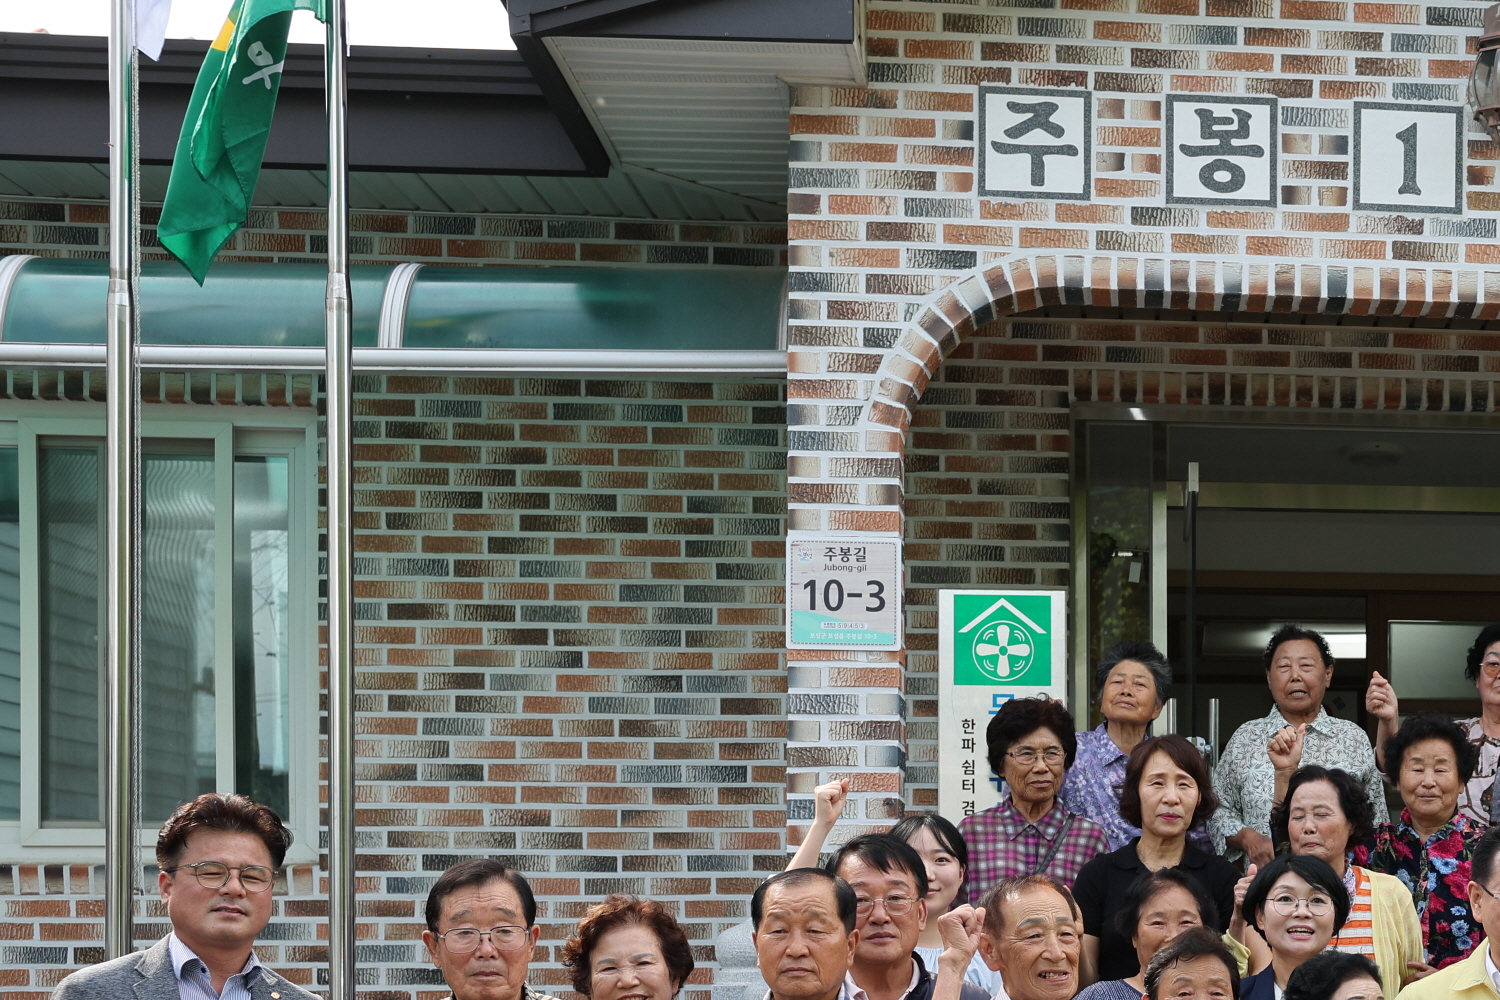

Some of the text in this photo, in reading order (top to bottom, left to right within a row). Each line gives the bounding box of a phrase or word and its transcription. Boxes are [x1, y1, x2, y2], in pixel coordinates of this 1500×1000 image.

[823, 546, 867, 563] 주봉길
[823, 564, 867, 573] Jubong-gil
[803, 579, 886, 613] 10-3
[810, 632, 827, 640] 보성군
[846, 632, 863, 640] 주봉길
